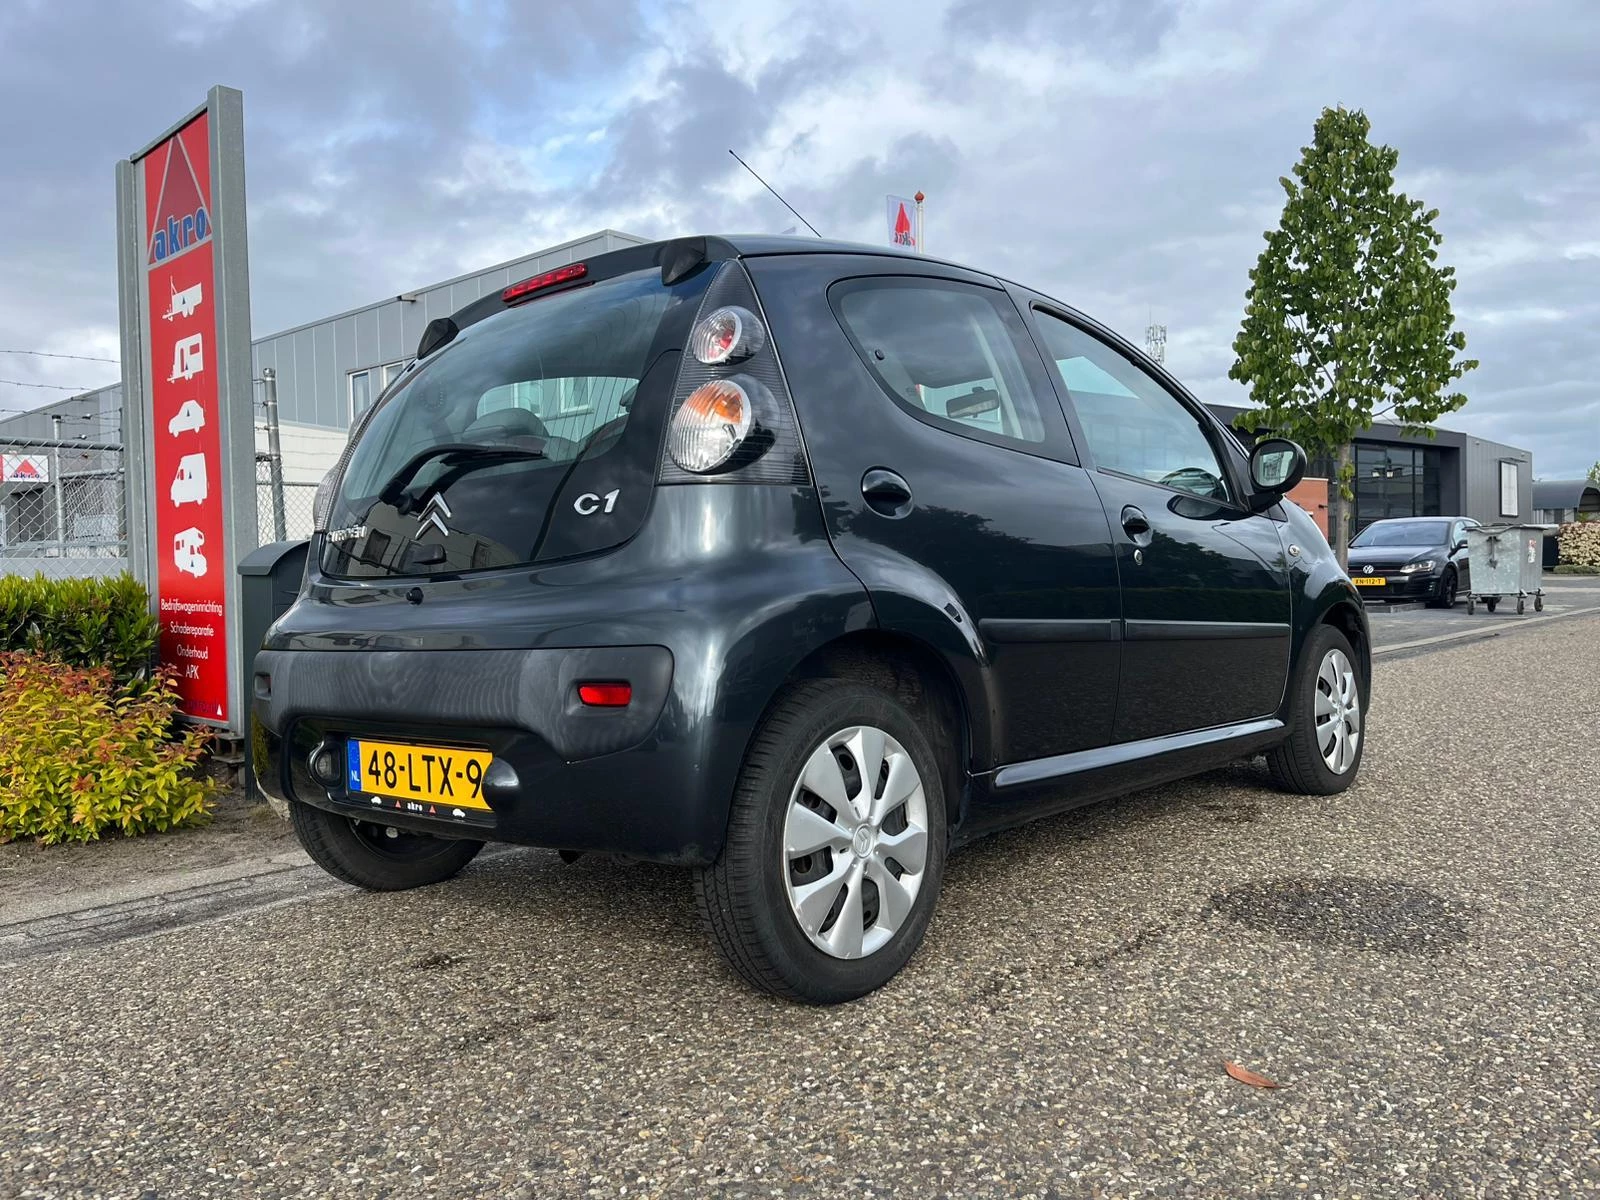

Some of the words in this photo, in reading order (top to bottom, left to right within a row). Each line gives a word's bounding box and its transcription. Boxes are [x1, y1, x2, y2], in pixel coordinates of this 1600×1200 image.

[154, 206, 207, 262] akro
[573, 488, 620, 515] C1
[160, 598, 223, 617] Bedrijfswageninrichting
[170, 621, 214, 638] Schadereparatie
[176, 644, 209, 660] Onderhoud
[186, 664, 200, 680] APK
[351, 769, 360, 782] NL
[367, 750, 483, 799] 48-LTX-9
[406, 801, 424, 812] akro
